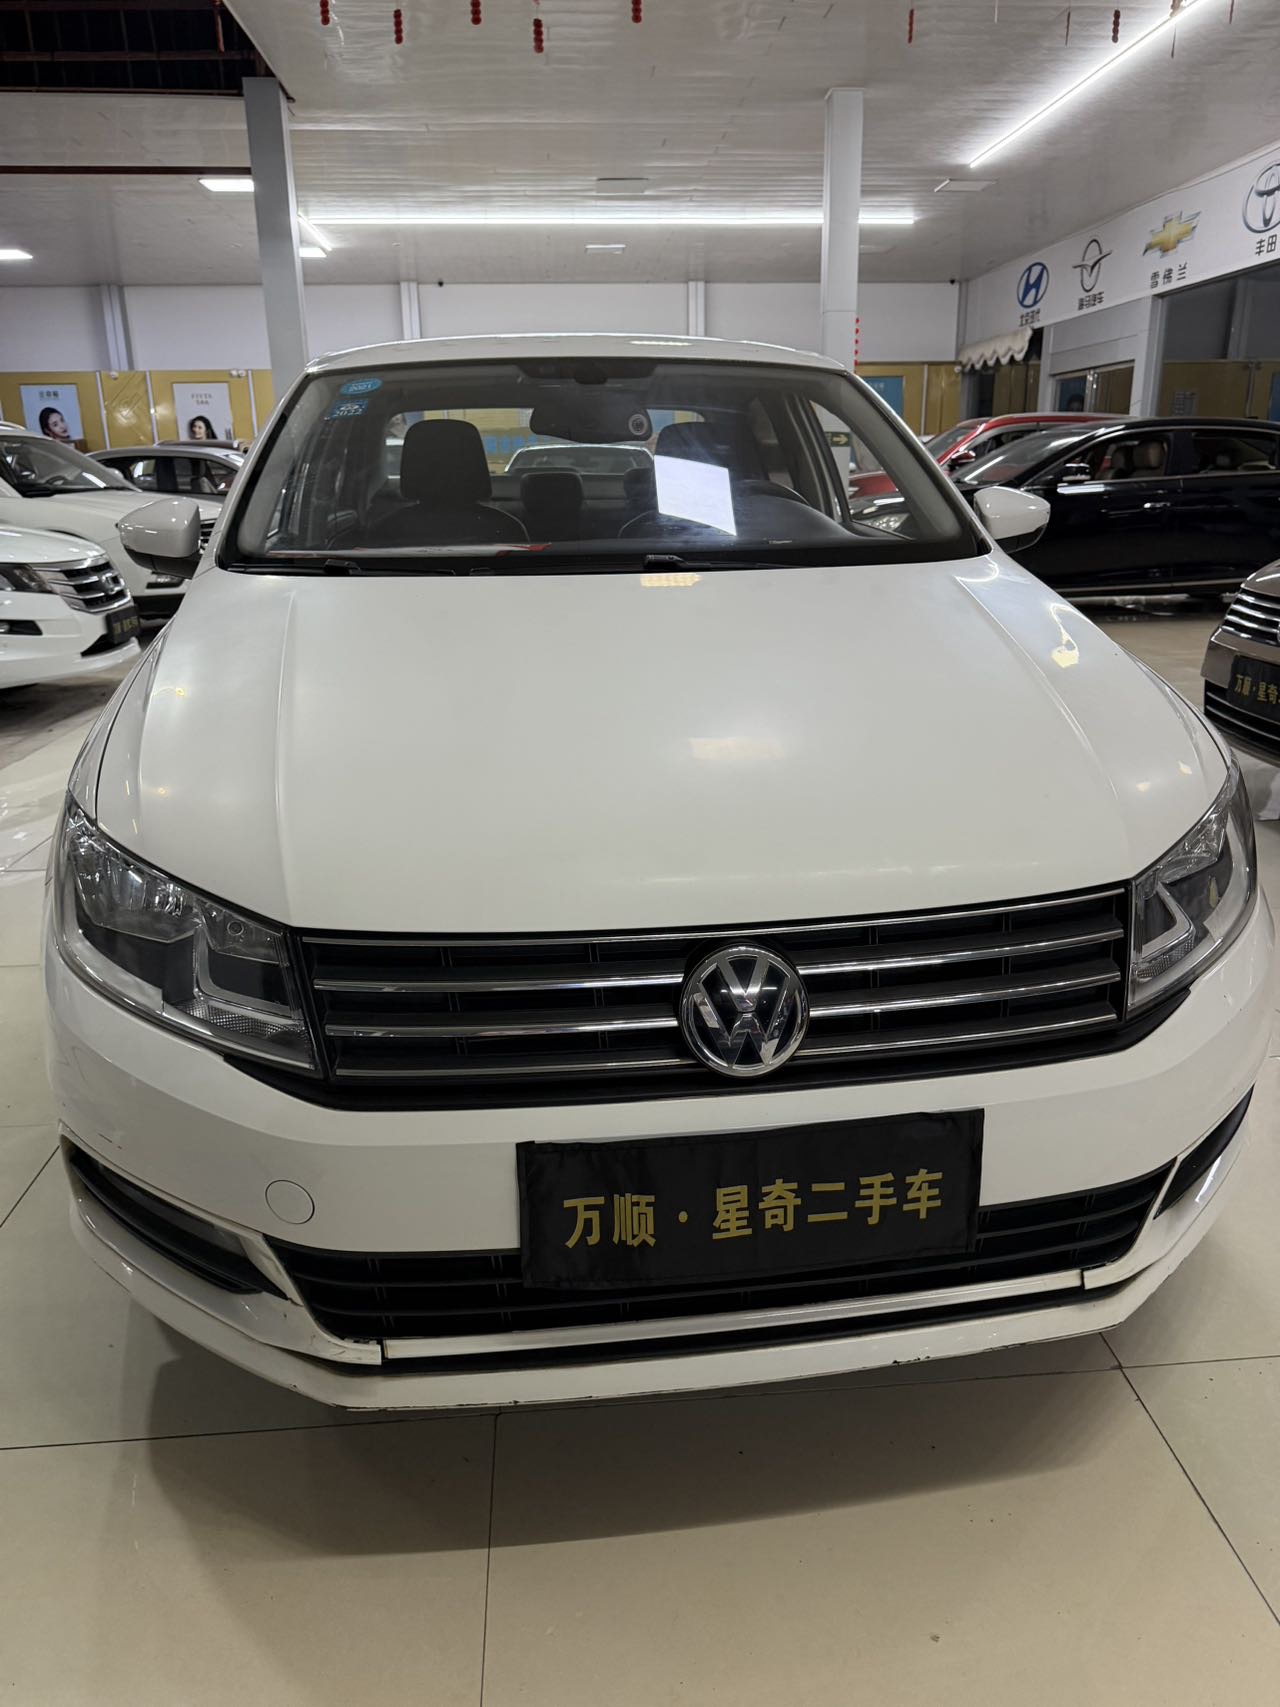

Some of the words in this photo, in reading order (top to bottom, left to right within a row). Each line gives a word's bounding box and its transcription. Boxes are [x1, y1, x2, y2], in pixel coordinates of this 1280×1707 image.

[1255, 234, 1278, 256] 丰田
[1150, 262, 1188, 289] 雪佛兰
[1234, 674, 1280, 705] 万顺·星奇
